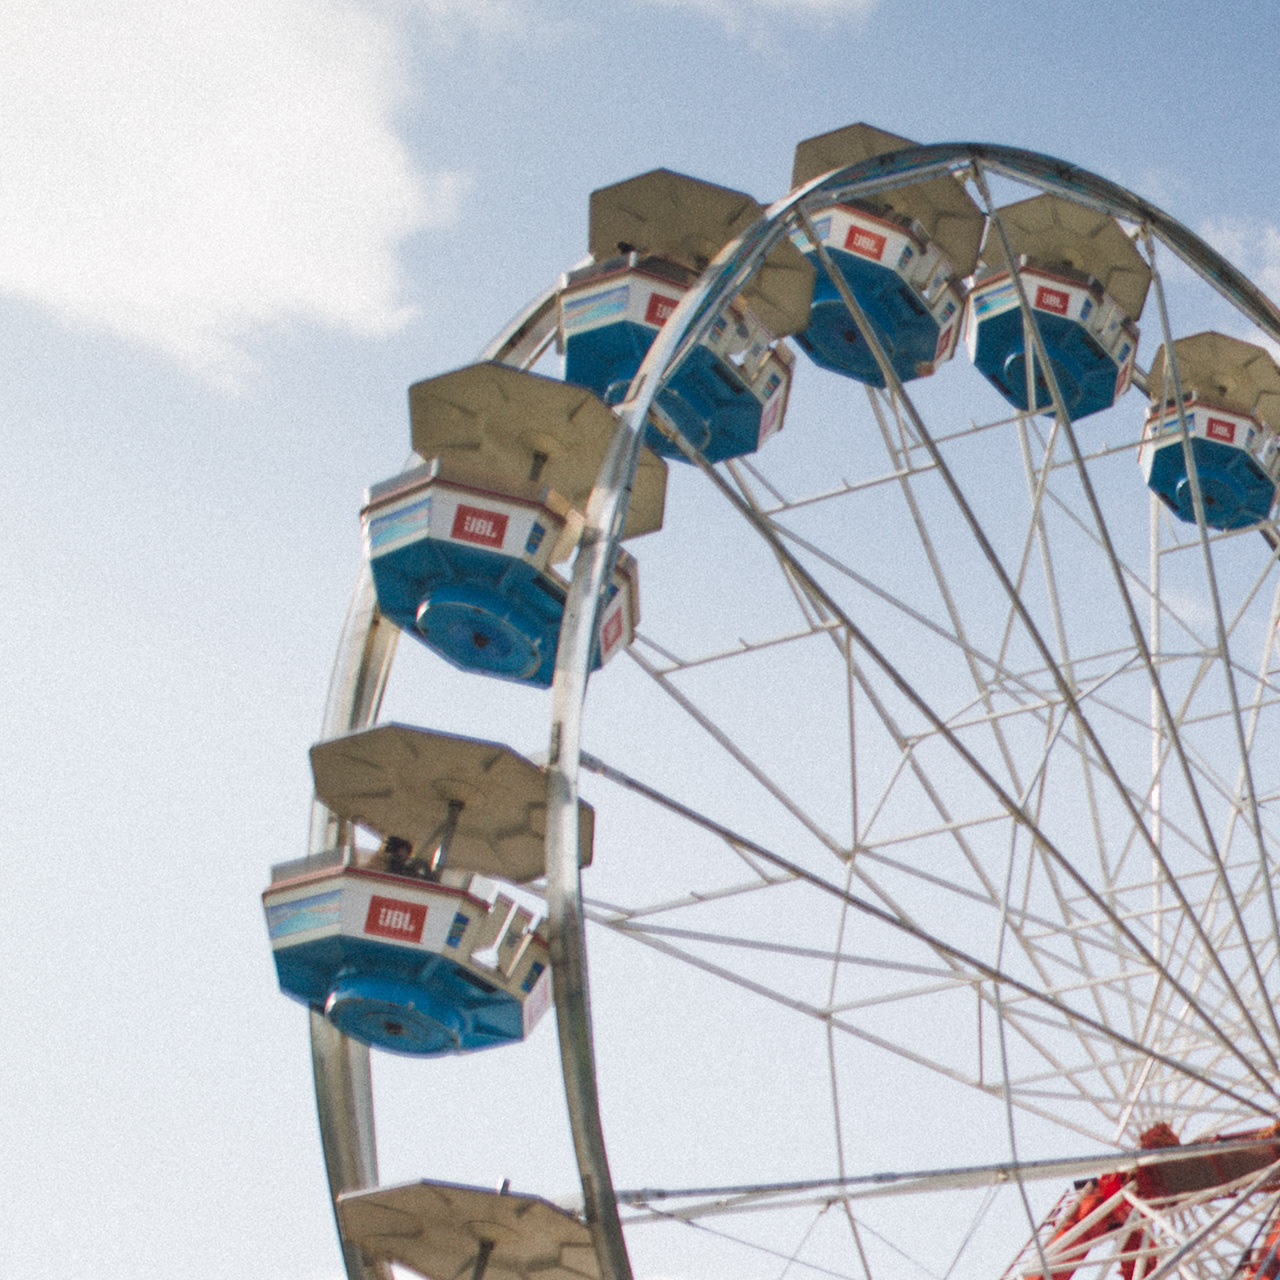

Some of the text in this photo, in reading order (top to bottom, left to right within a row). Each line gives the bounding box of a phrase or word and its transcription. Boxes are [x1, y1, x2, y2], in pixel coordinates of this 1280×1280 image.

[853, 232, 879, 254] JBL
[464, 516, 497, 538] JBL
[379, 907, 415, 932] JBL
